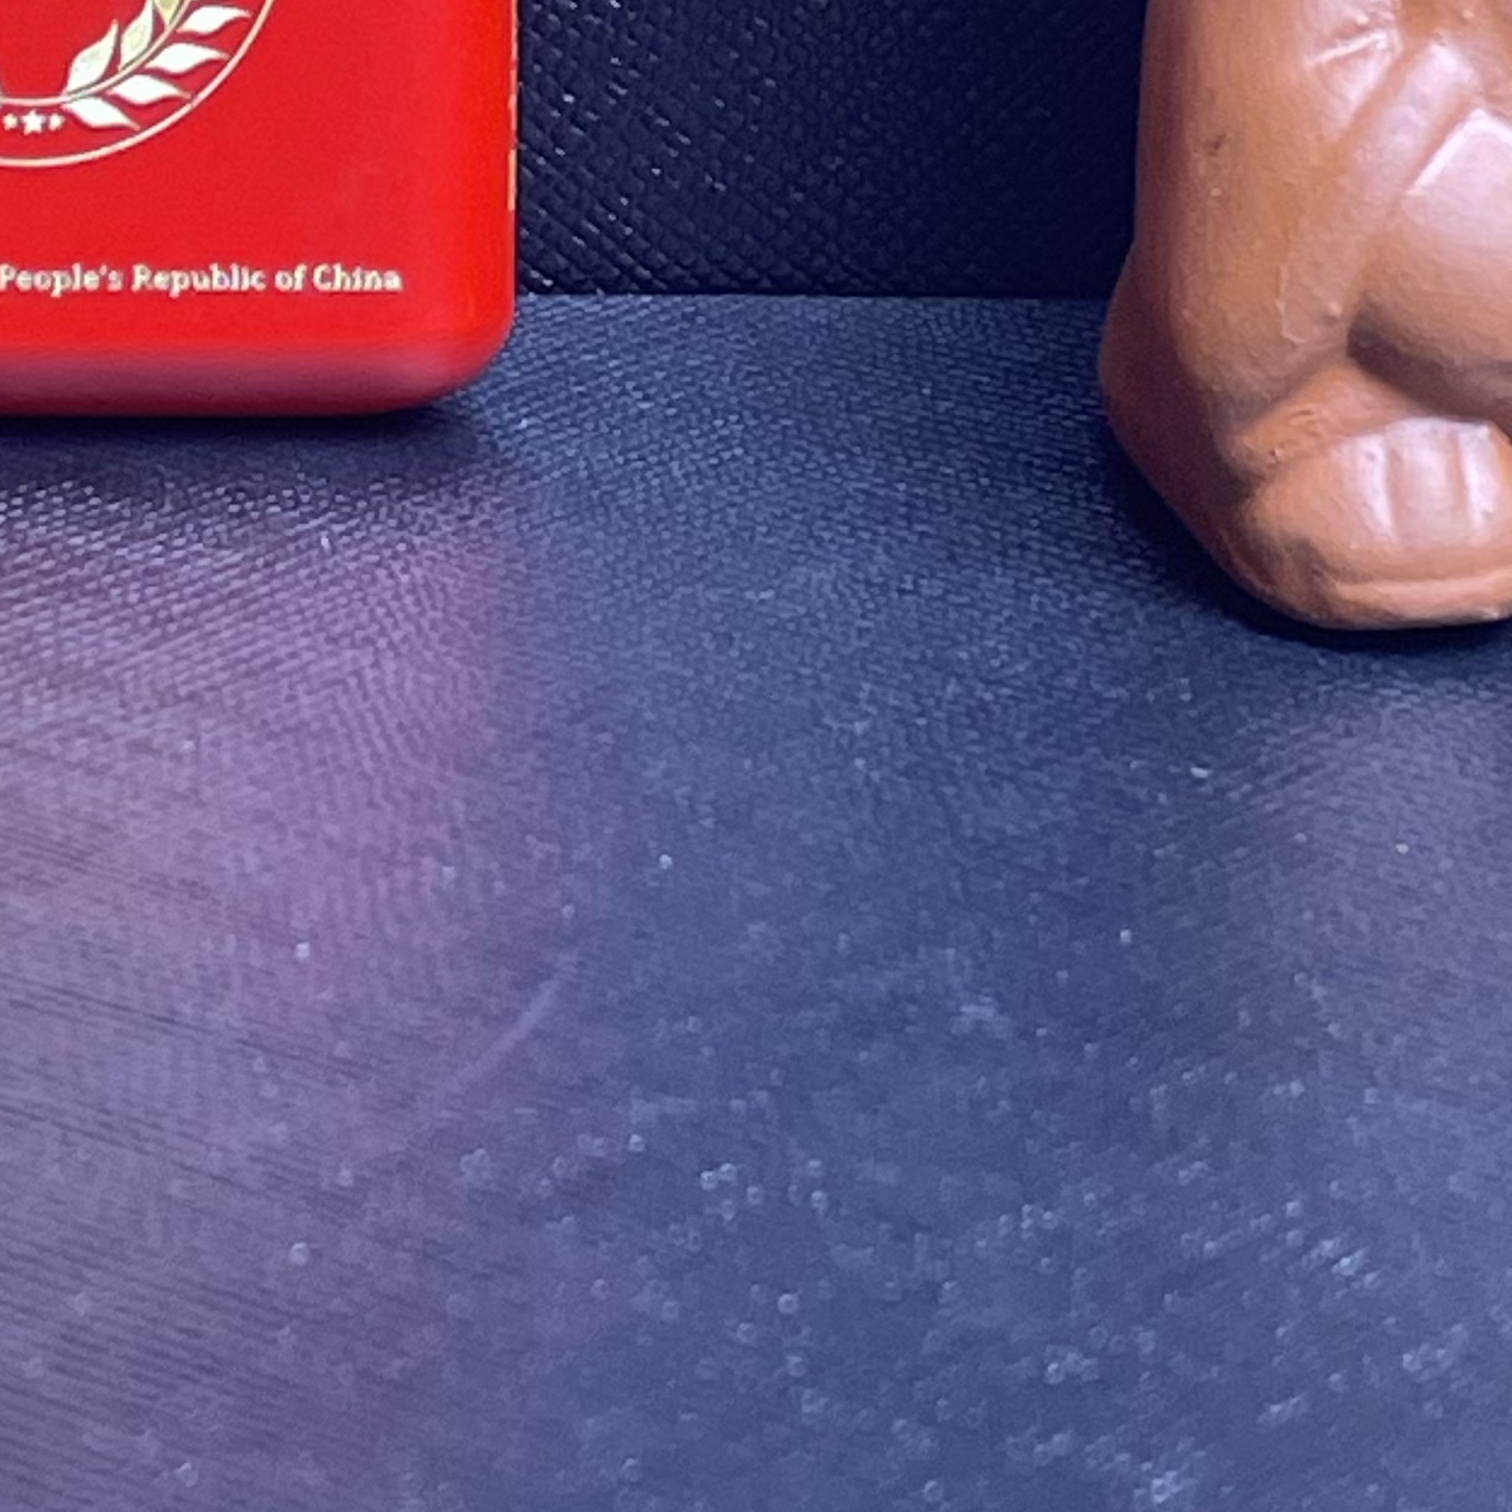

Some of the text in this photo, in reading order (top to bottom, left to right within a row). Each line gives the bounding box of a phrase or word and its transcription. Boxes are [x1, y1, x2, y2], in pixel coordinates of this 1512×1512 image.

[131, 263, 267, 298] Republic
[274, 263, 306, 291] of
[312, 263, 402, 292] China
